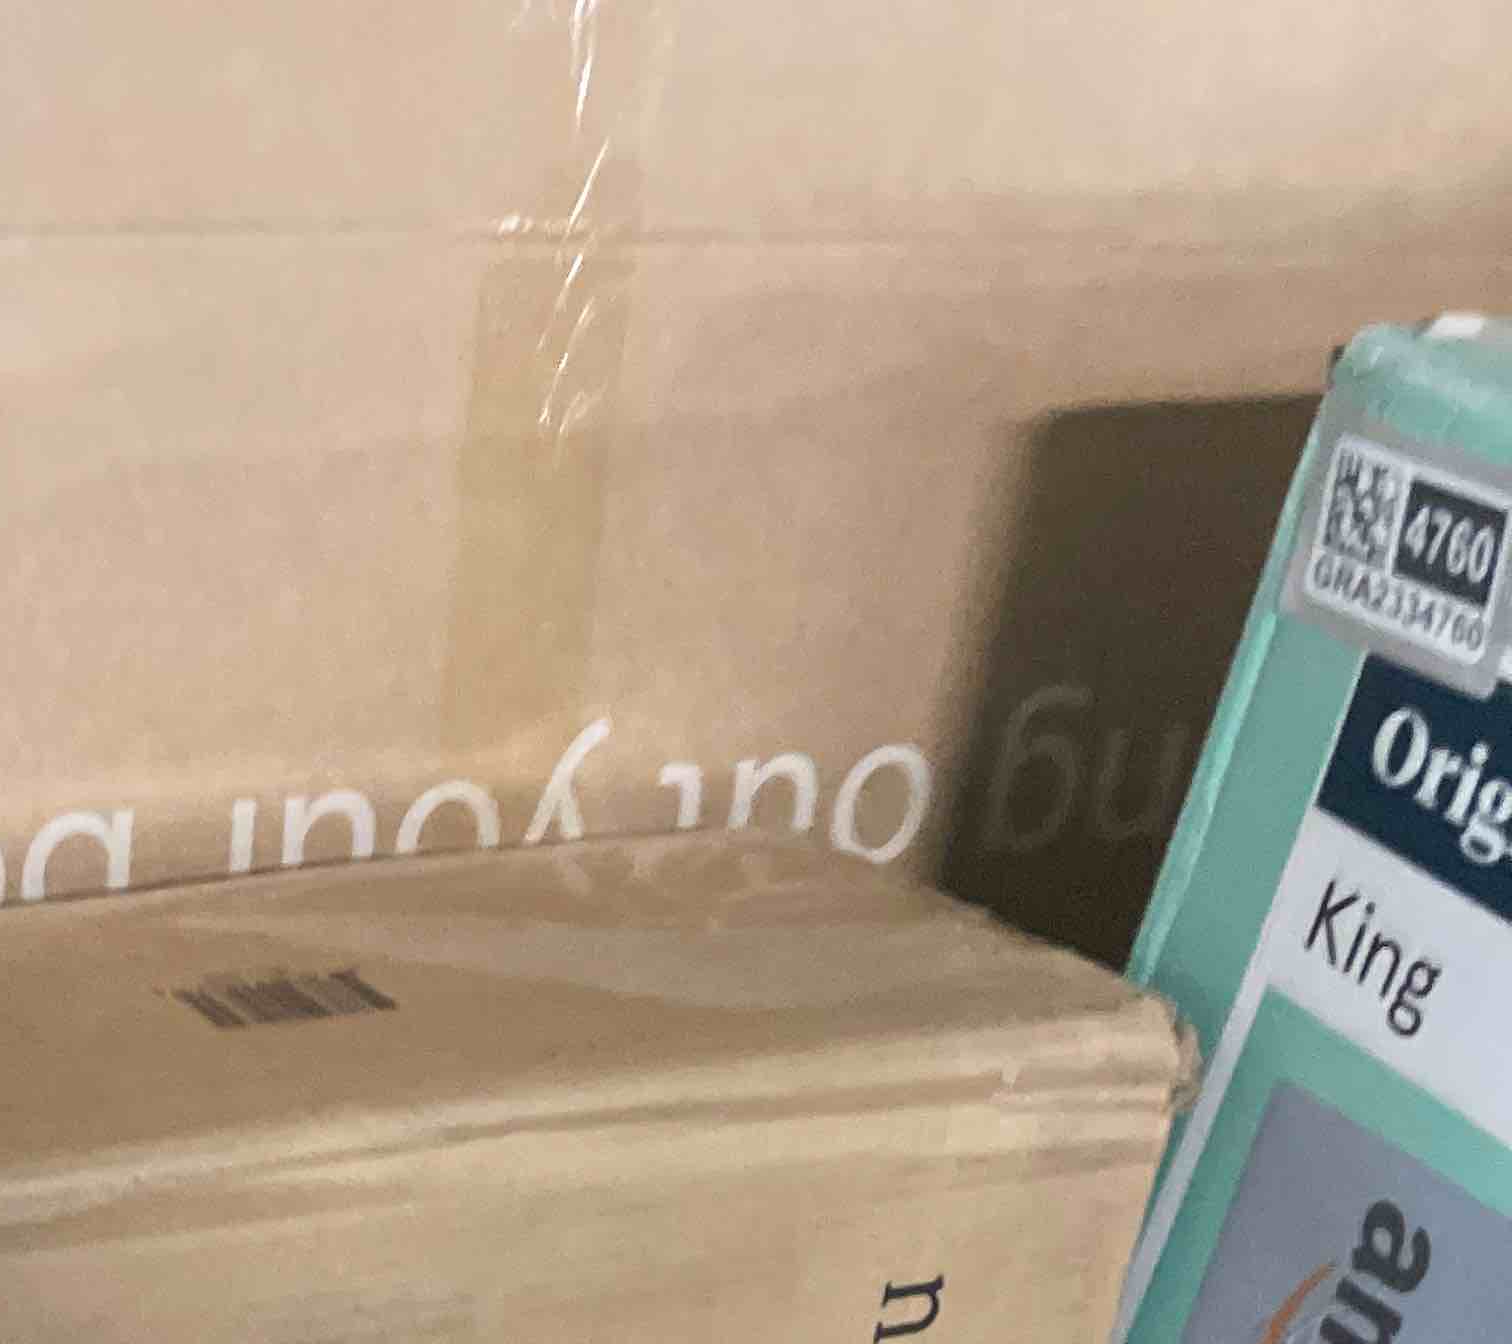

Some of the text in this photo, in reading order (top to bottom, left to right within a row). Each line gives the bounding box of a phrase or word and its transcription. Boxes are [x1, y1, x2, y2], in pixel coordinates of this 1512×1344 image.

[1405, 502, 1496, 585] 4760
[1370, 704, 1512, 866] Orig
[1302, 878, 1444, 1037] King
